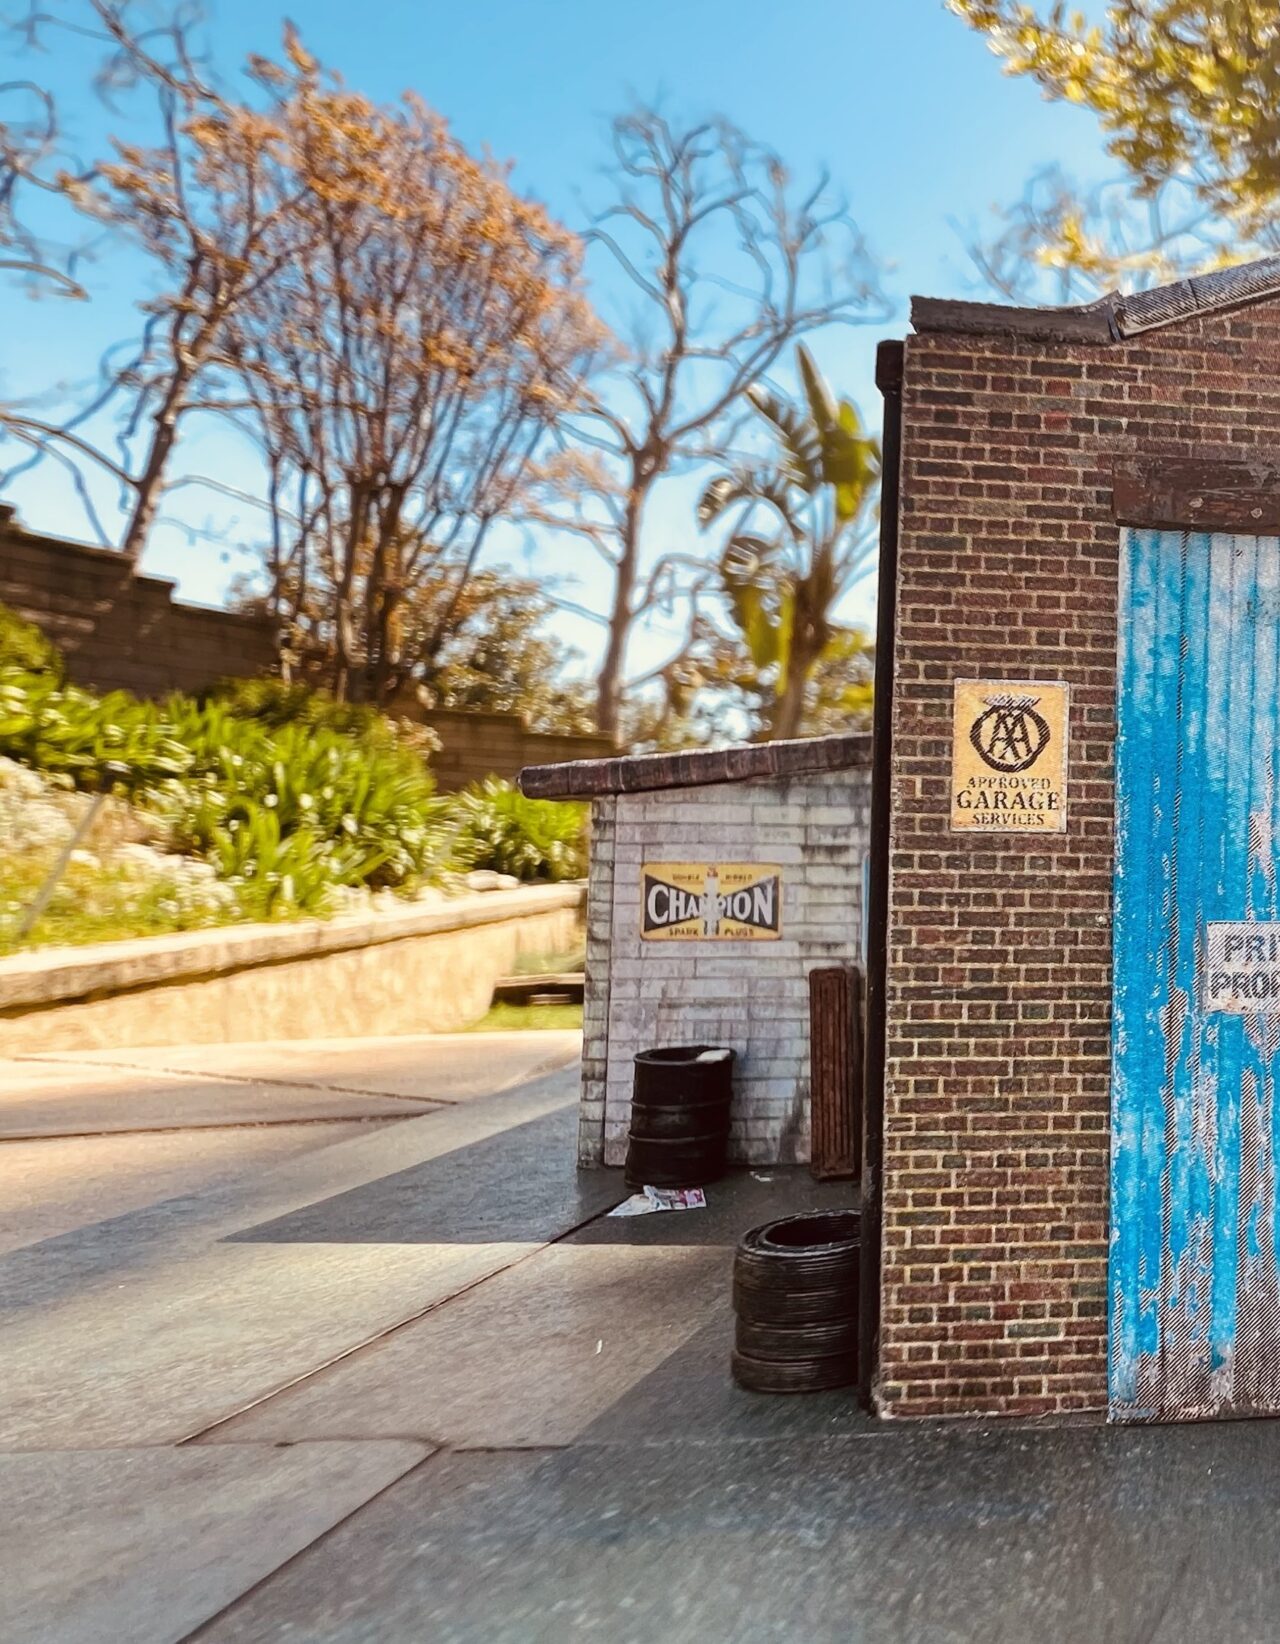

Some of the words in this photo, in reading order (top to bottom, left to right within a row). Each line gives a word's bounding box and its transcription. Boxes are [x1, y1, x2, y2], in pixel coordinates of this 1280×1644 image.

[966, 776, 1051, 790] APPROVED
[956, 790, 1060, 811] GARAGE
[971, 812, 1046, 826] SERVICES
[647, 880, 775, 925] CHAPION
